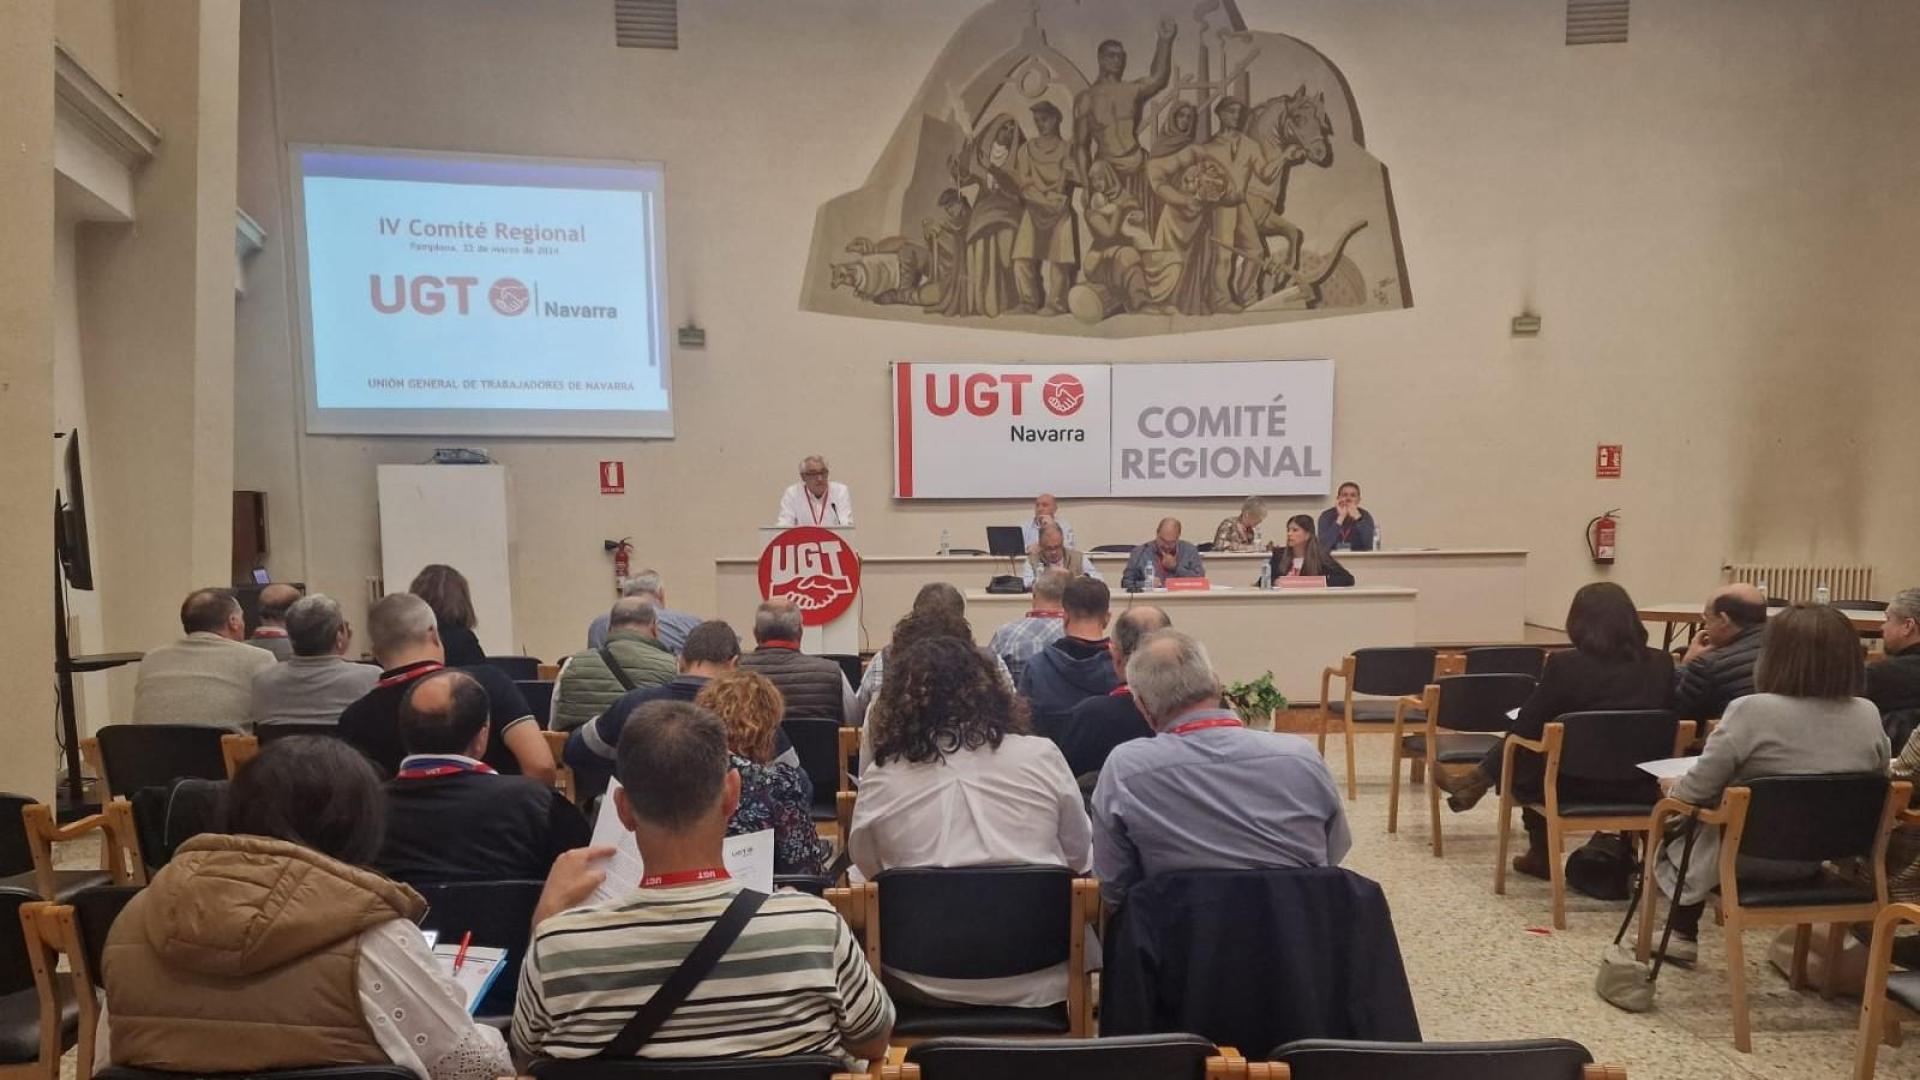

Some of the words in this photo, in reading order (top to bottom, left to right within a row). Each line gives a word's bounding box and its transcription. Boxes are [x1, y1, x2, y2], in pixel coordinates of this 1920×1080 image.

[379, 217, 401, 236] IV
[409, 218, 488, 239] Comité
[495, 221, 586, 245] Regional
[369, 274, 479, 315] UGT
[544, 301, 618, 319] Navarra
[408, 379, 459, 389] GENERAL
[463, 379, 478, 390] DE
[480, 379, 564, 391] TRABAJADORES
[569, 381, 584, 391] DE
[586, 381, 634, 392] NAVARRA
[925, 373, 1032, 417] UGT
[1138, 394, 1288, 438] COMITÉ
[1010, 425, 1085, 443] Navarra
[1121, 446, 1322, 480] REGIONAL
[770, 540, 844, 581] UGT
[697, 870, 716, 879] UGT
